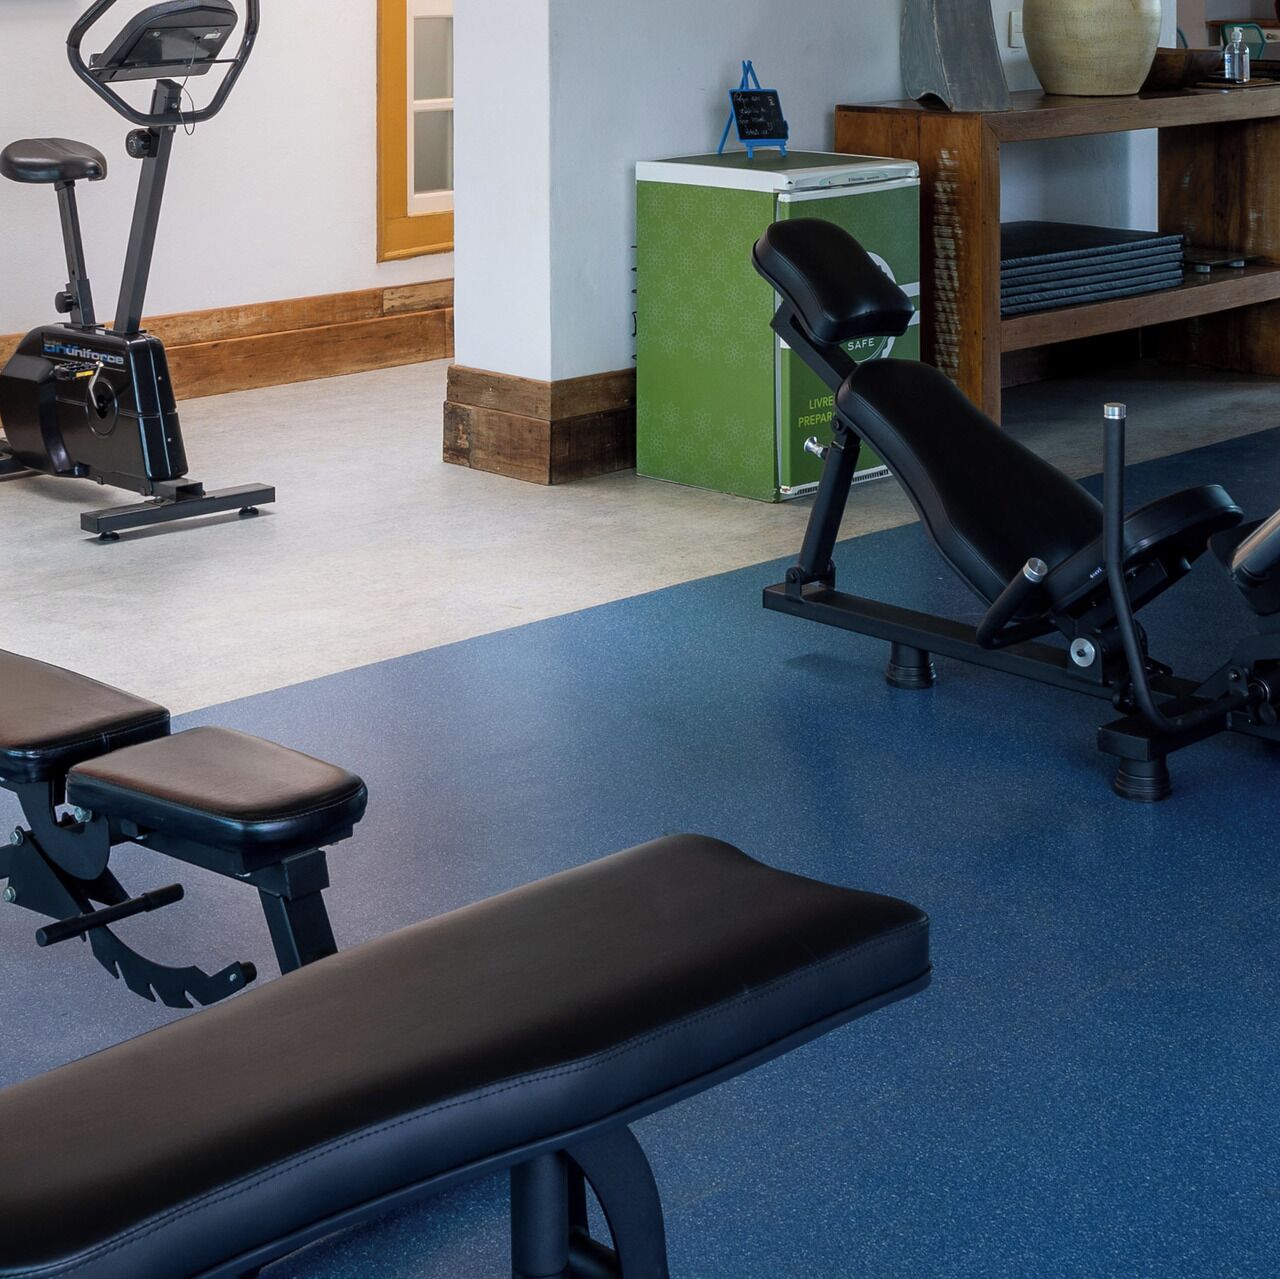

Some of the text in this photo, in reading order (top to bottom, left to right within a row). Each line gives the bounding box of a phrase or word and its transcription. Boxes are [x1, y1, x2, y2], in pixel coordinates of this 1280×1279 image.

[847, 338, 875, 351] SAFE
[809, 396, 833, 409] LIVRE
[798, 411, 836, 428] PREPAR
